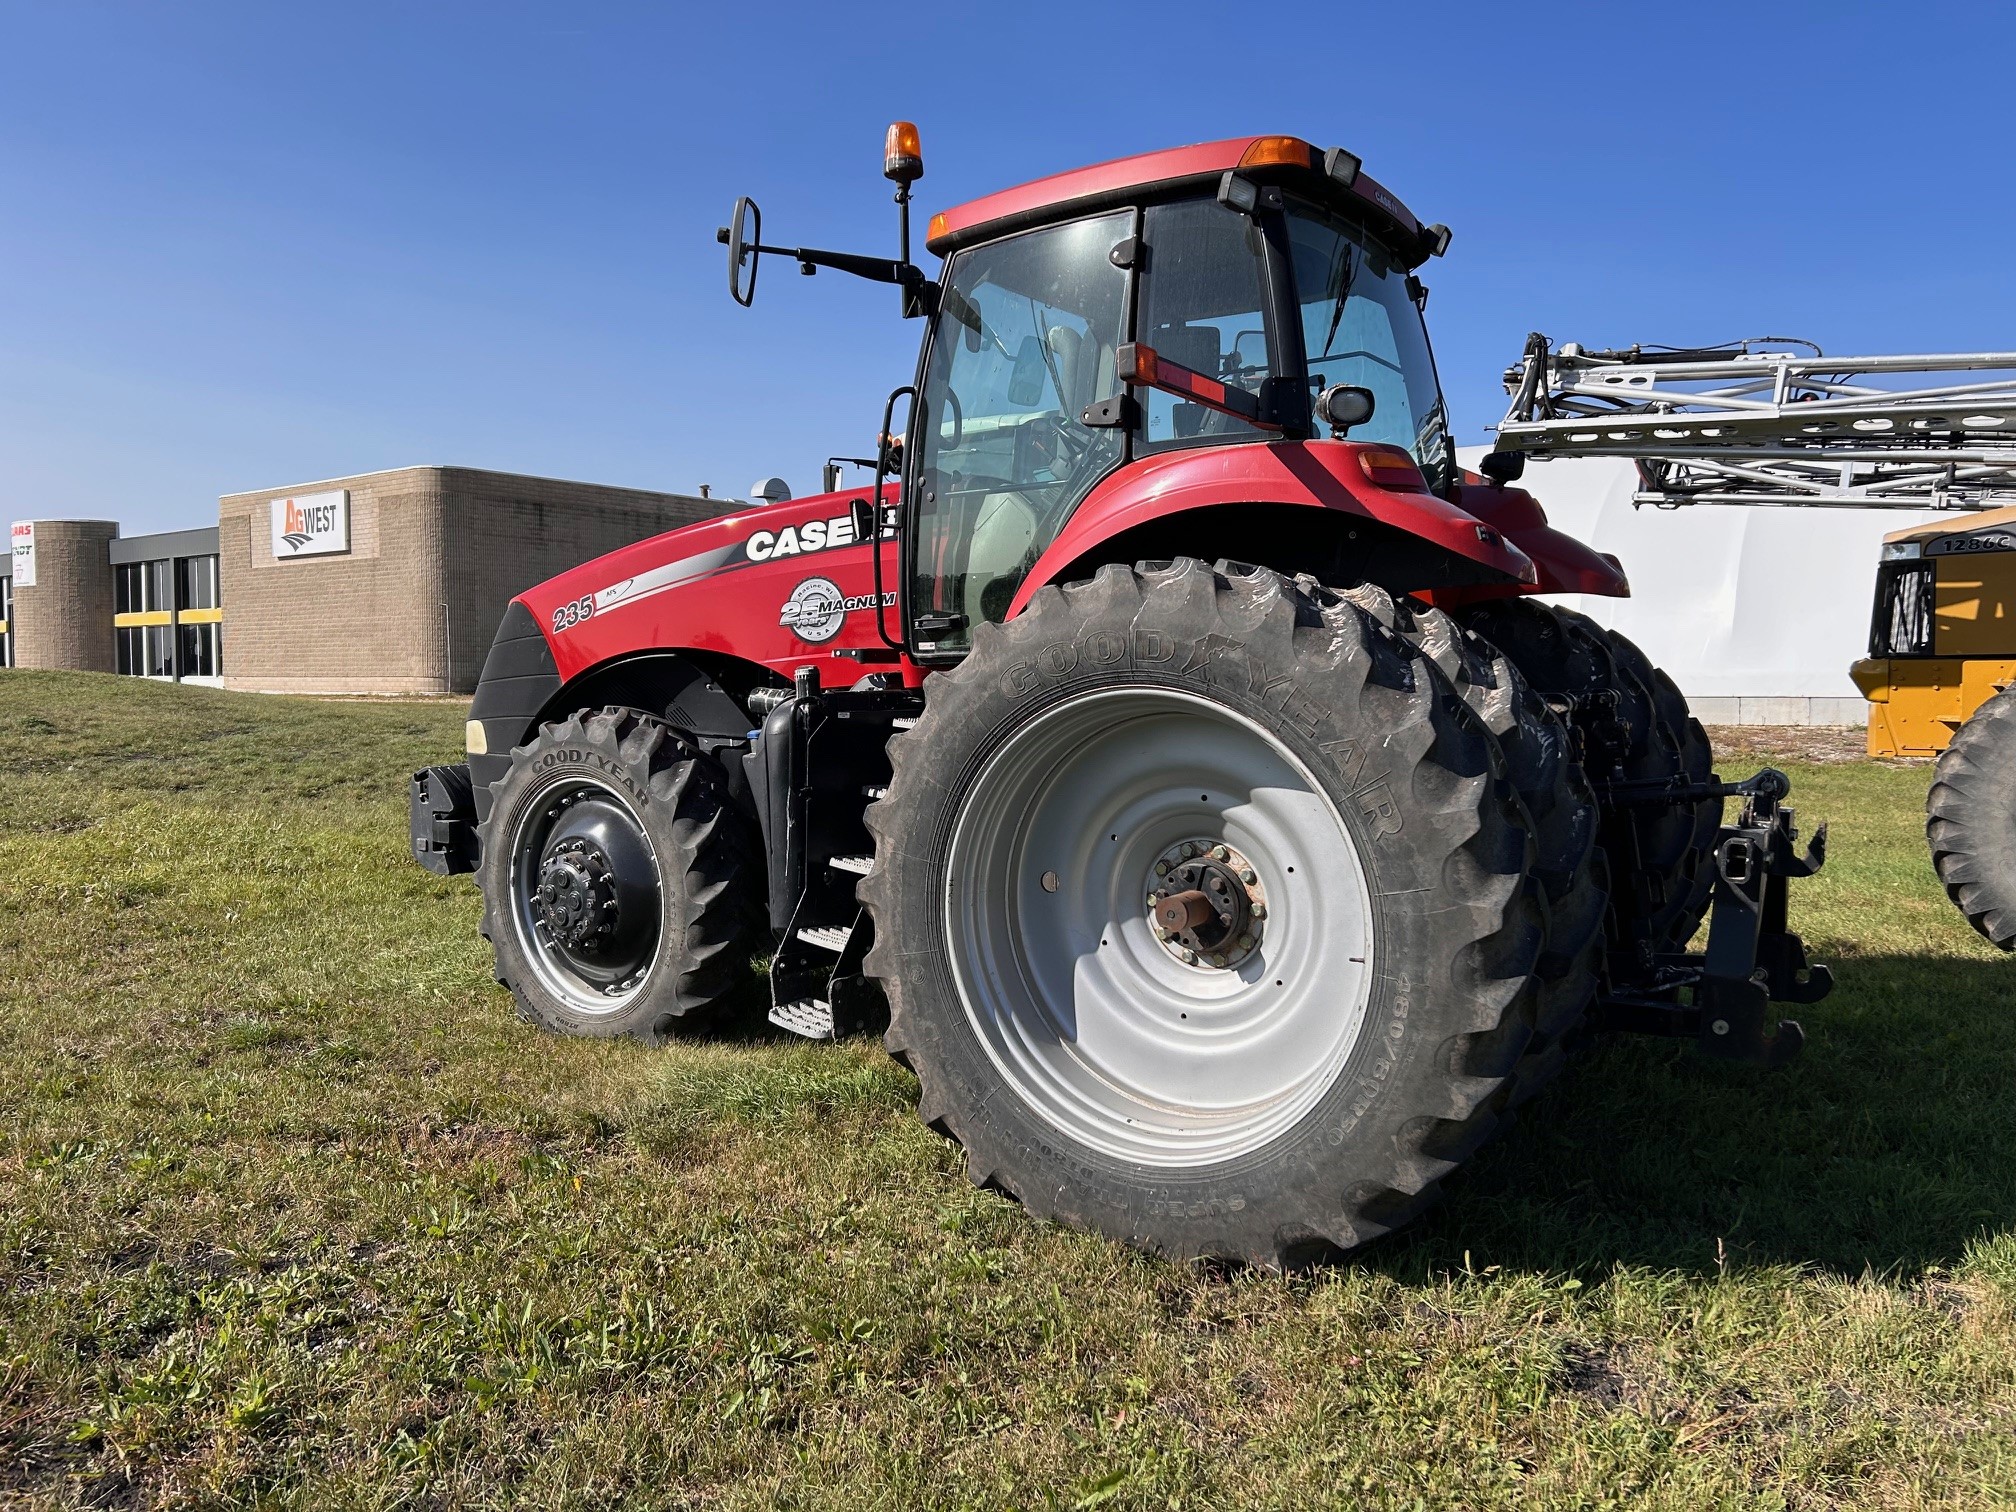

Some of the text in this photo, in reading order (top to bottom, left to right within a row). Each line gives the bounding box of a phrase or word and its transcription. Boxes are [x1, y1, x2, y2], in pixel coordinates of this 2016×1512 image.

[1943, 535, 2011, 552] 1286C
[825, 587, 834, 595] WI
[817, 592, 897, 614] MAGNUM
[552, 594, 594, 635] 235
[796, 615, 829, 628] years
[1000, 628, 1403, 842] GOODYEAR
[531, 749, 650, 809] GOODYEAR
